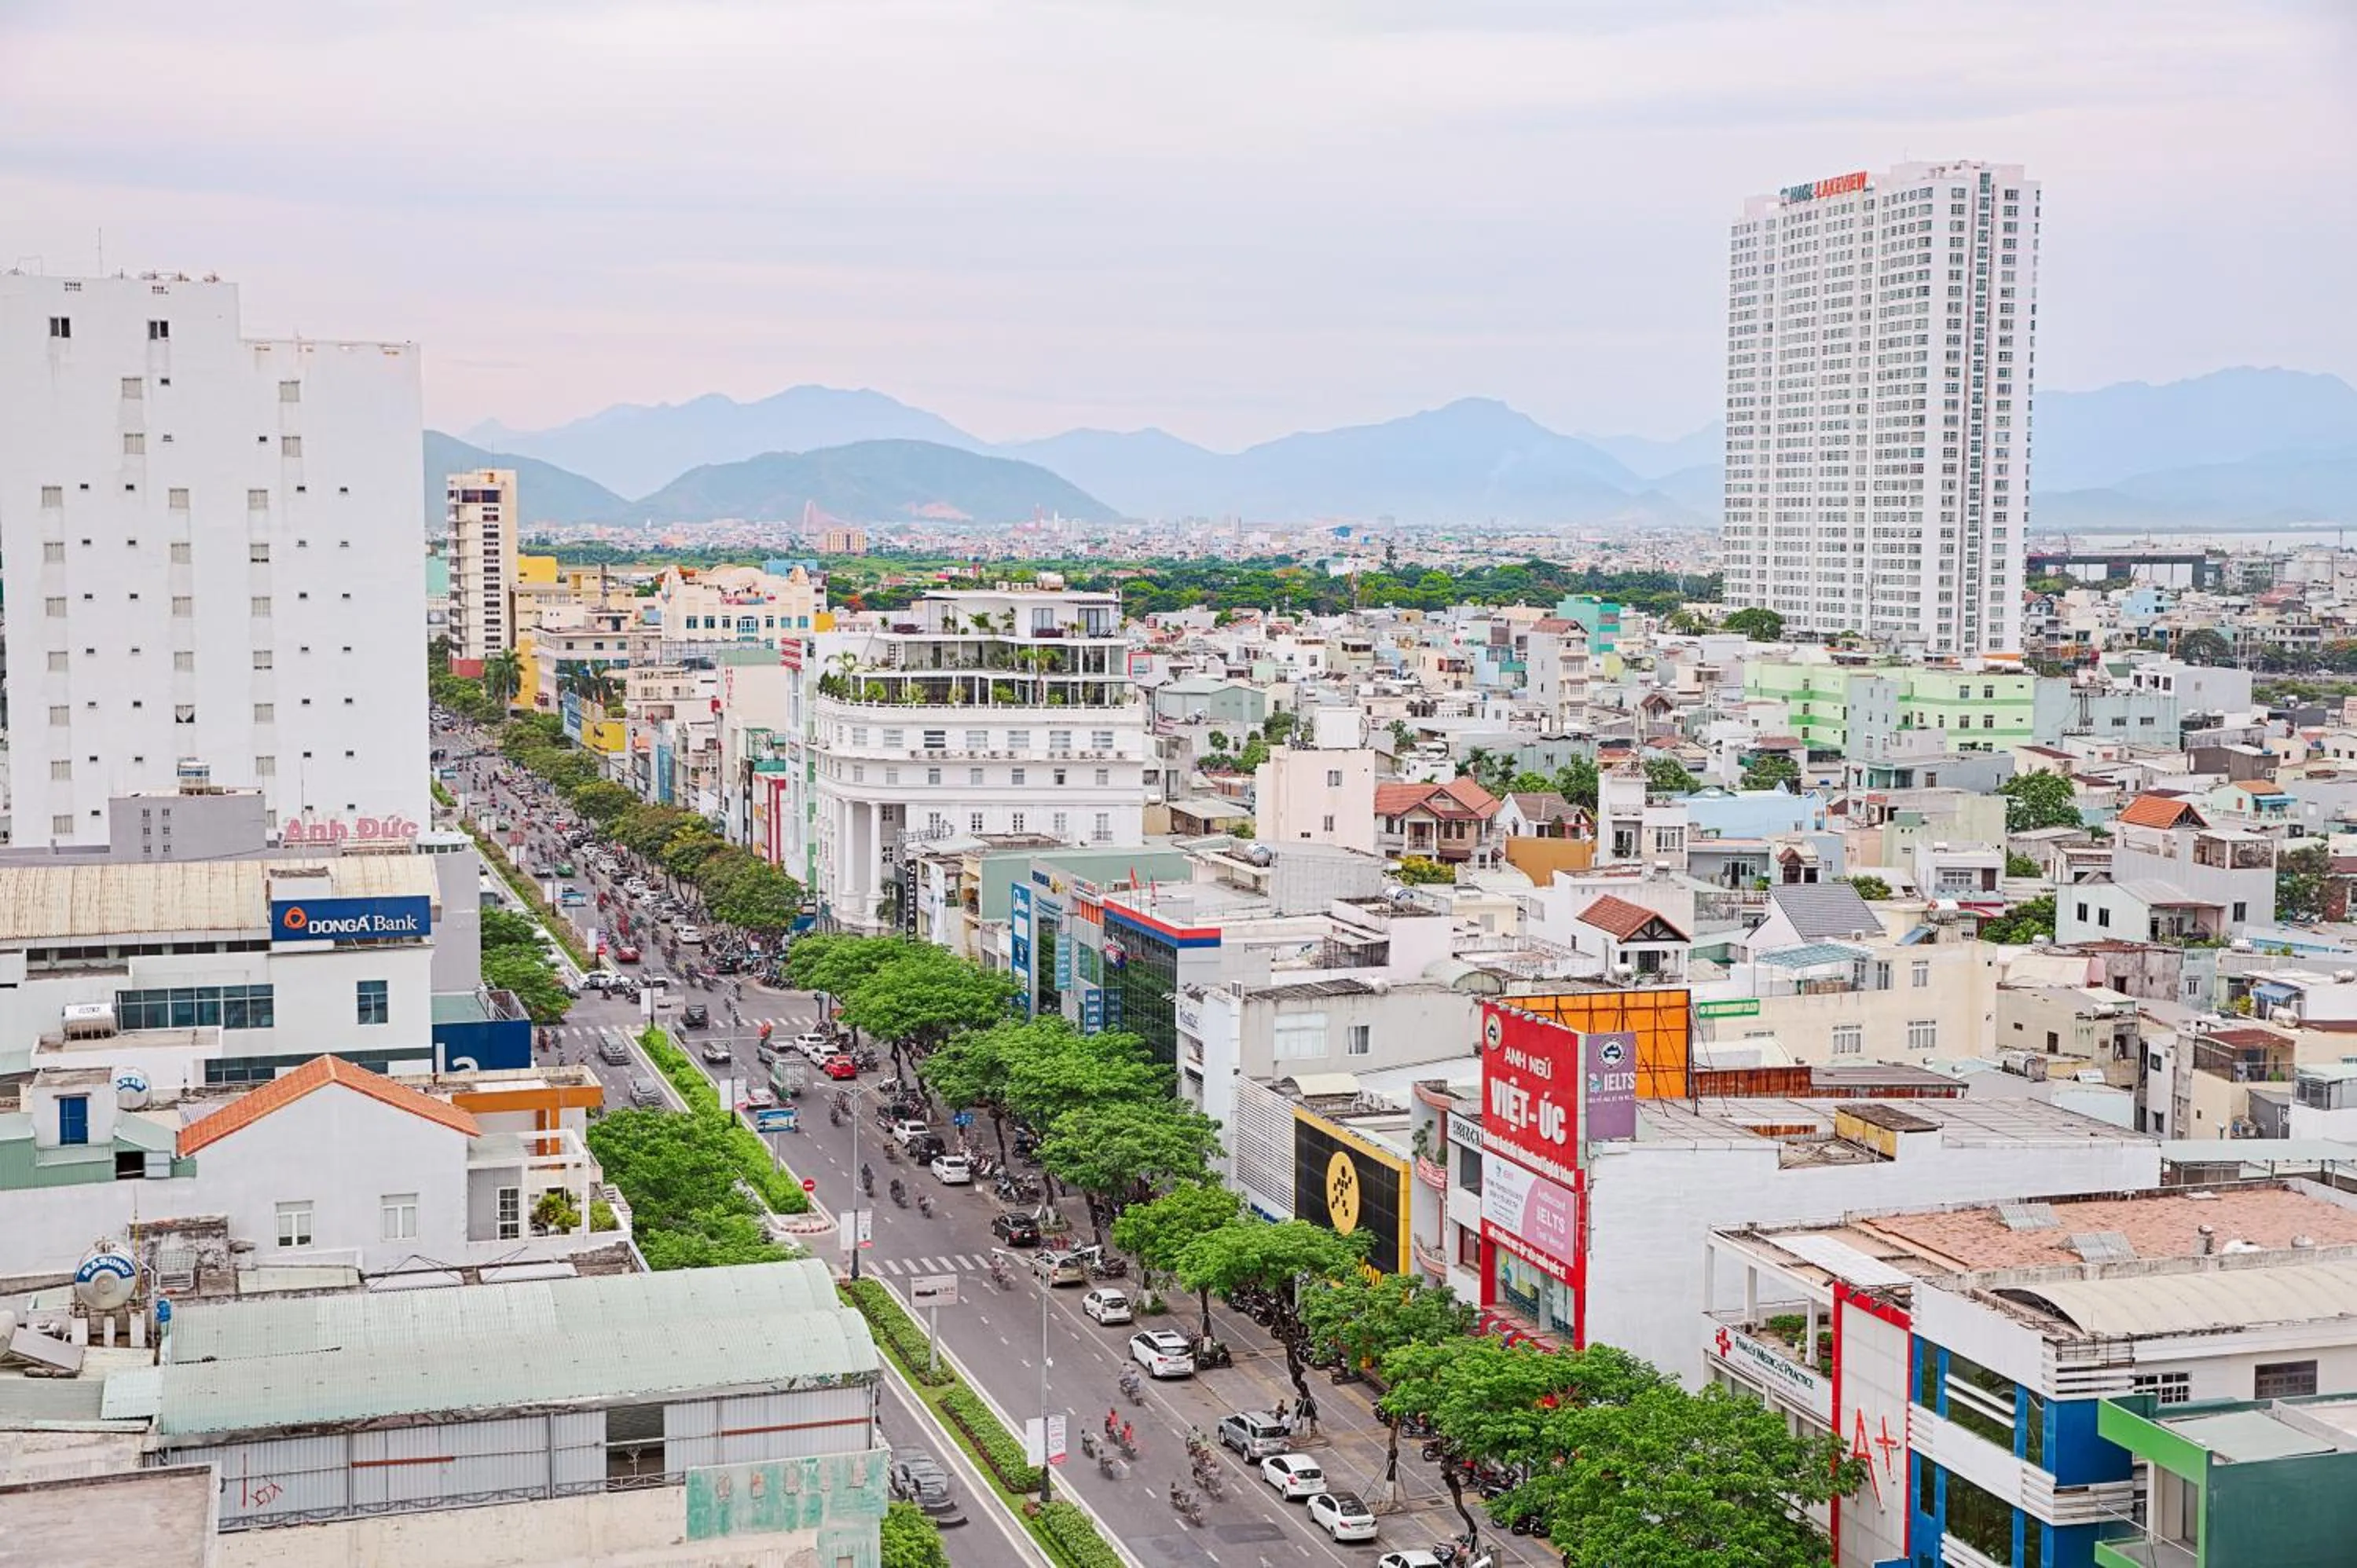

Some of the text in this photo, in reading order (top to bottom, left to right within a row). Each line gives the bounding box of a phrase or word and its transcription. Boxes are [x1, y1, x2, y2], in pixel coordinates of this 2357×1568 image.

[284, 814, 419, 843] Anh Đức
[372, 913, 418, 932] Bank
[1504, 1046, 1527, 1070] ANH
[1604, 1072, 1635, 1092] IELTS
[1536, 1206, 1567, 1235] IELTS
